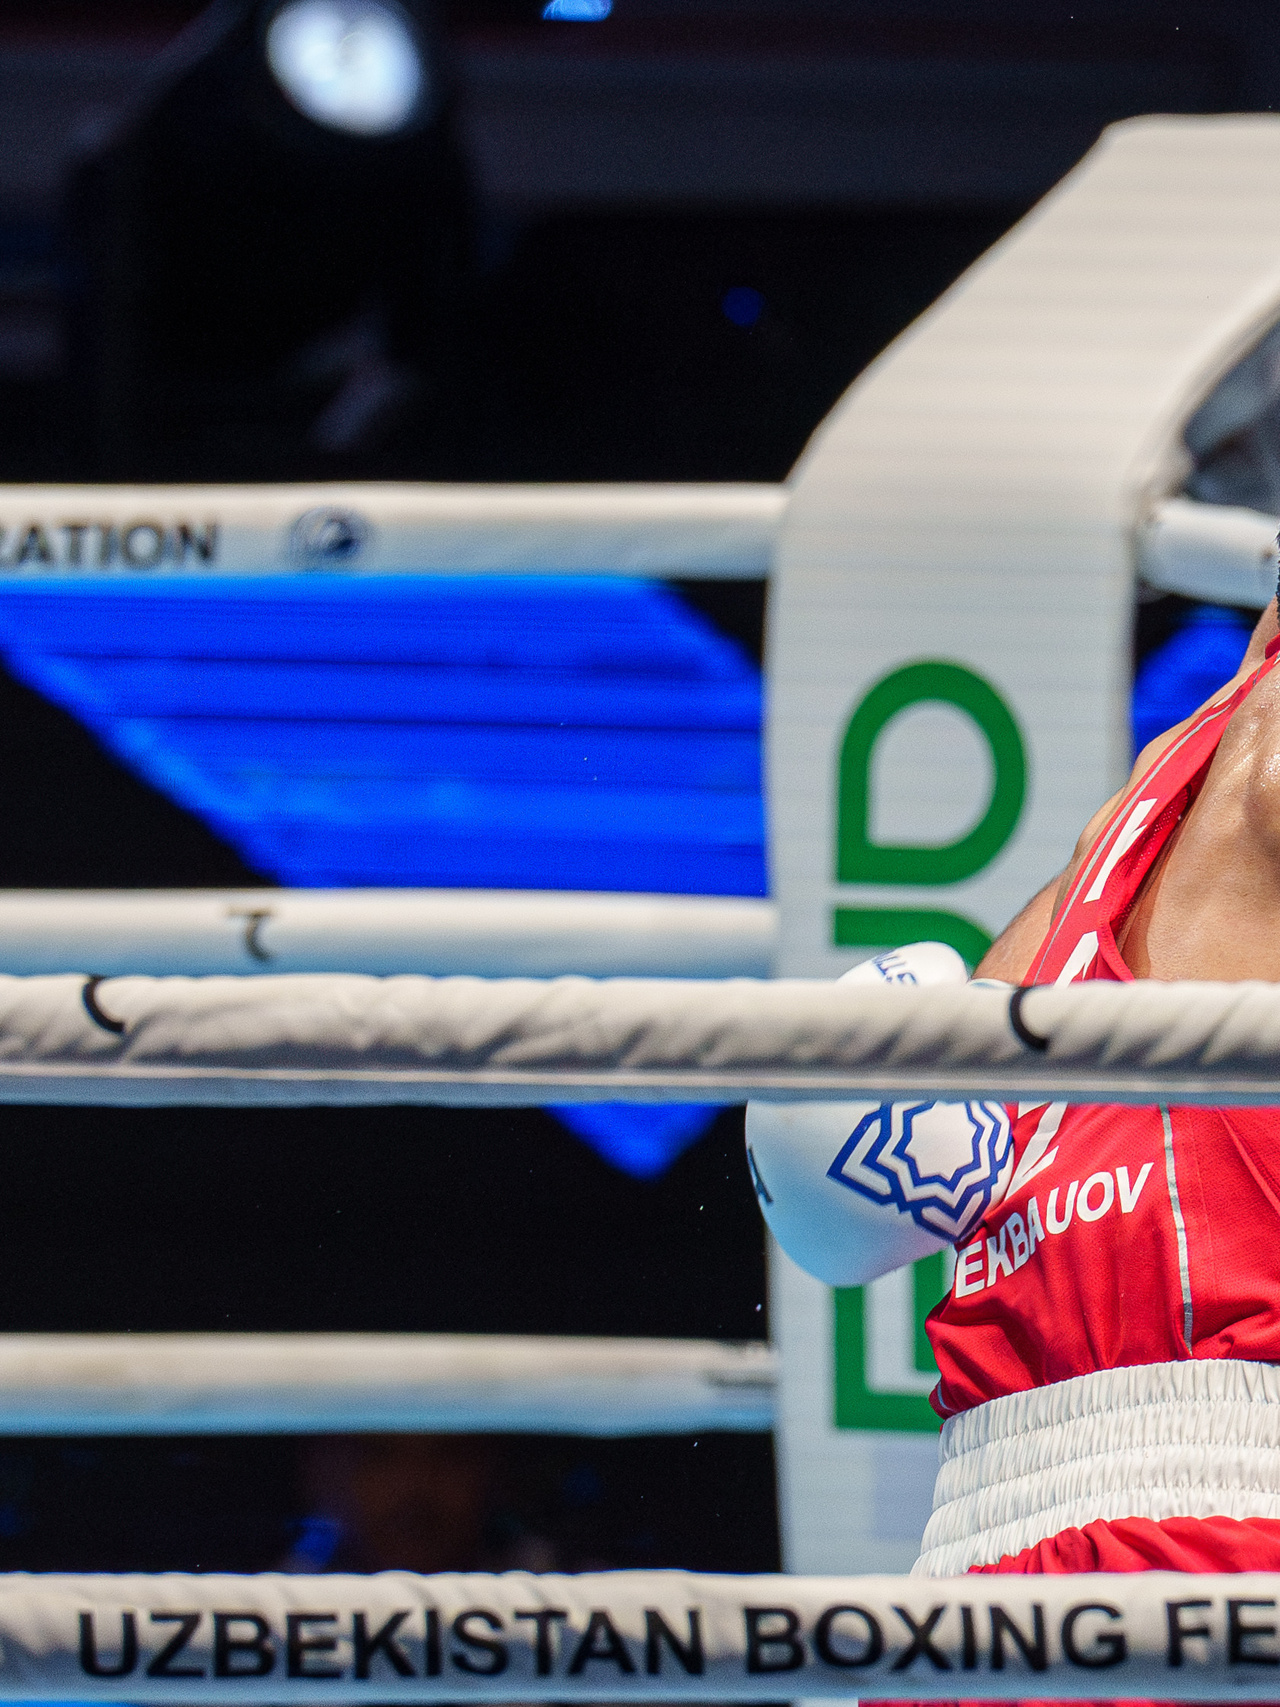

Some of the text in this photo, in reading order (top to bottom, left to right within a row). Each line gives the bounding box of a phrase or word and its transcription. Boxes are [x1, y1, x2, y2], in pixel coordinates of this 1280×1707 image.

[0, 517, 219, 569] ATION
[77, 1605, 705, 1679] UZBEKISTAN
[743, 1602, 1129, 1675] BOXING
